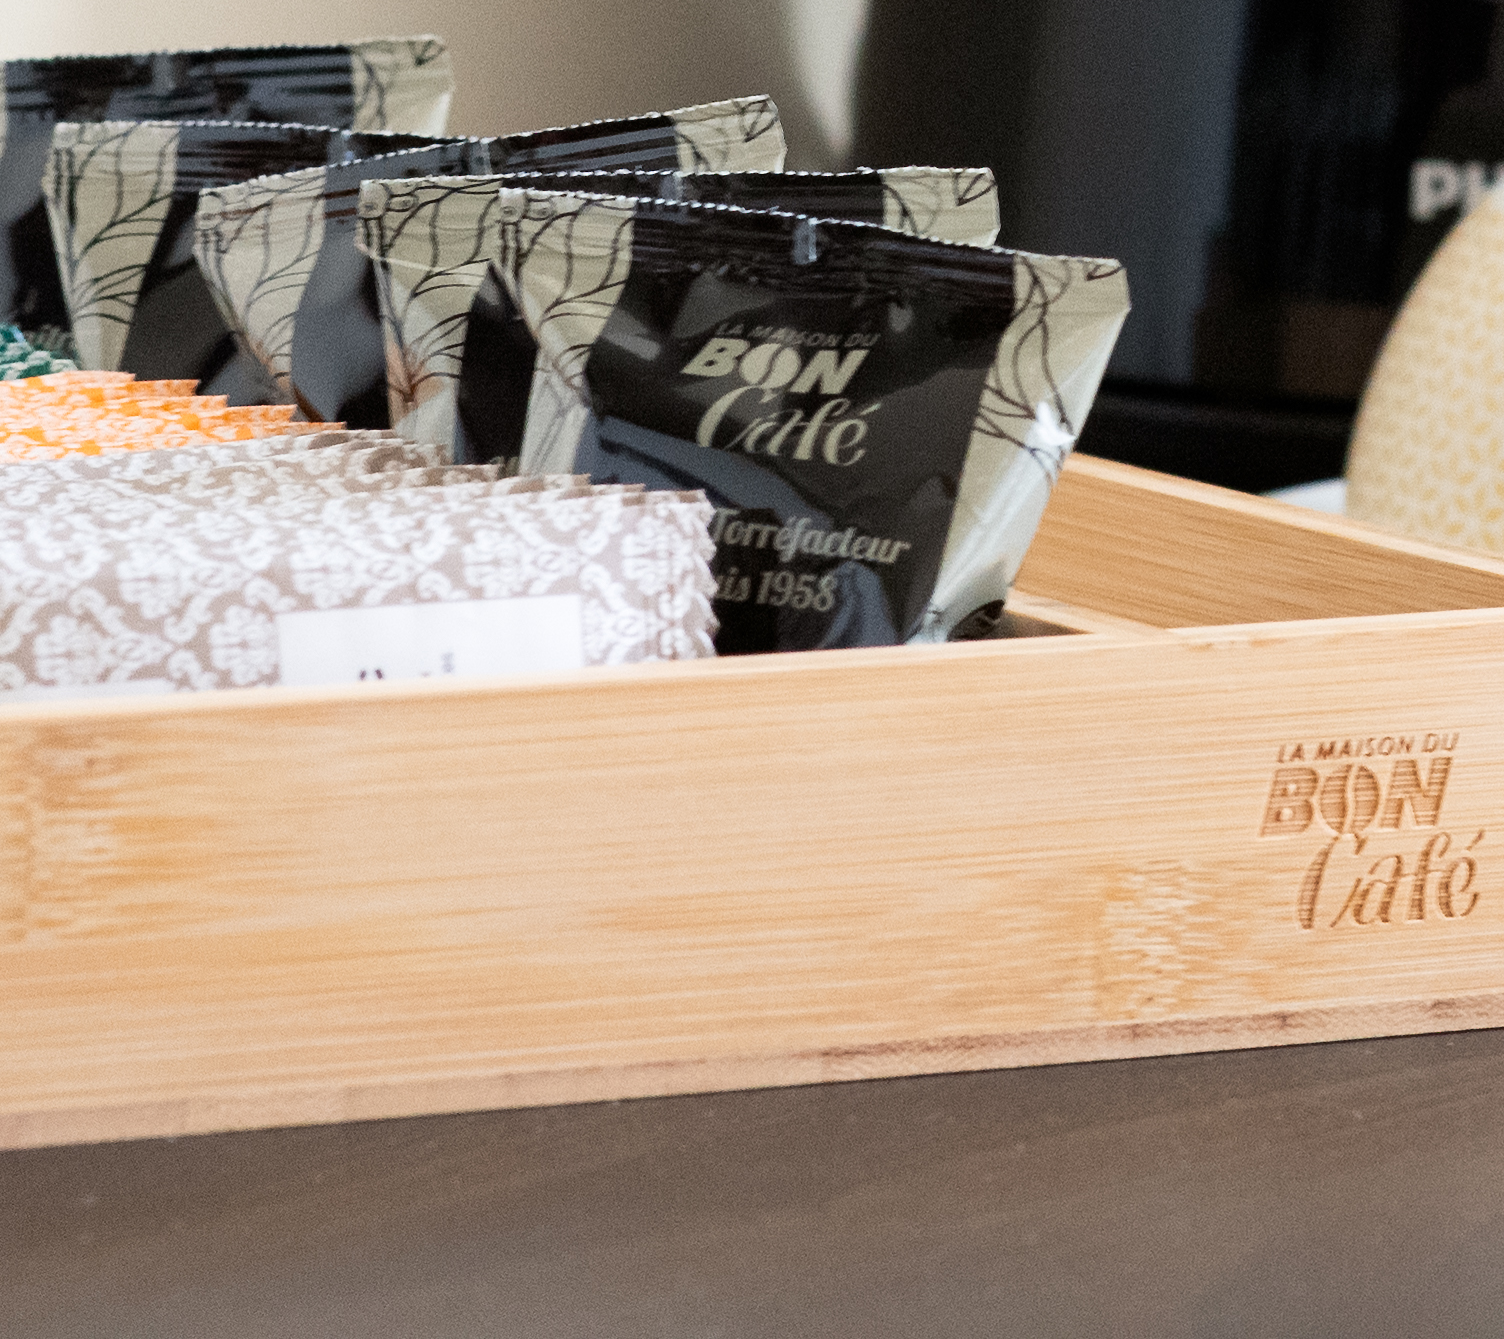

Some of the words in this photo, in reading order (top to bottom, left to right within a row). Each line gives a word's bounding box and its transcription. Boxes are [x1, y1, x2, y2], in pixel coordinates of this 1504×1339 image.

[680, 337, 871, 395] BON
[697, 385, 882, 467] Café
[755, 570, 839, 612] 1958
[1276, 743, 1306, 764] LA
[1314, 735, 1416, 761] MAISON
[1421, 732, 1461, 754] DU
[1258, 756, 1454, 838] BON
[1297, 828, 1487, 930] Café
